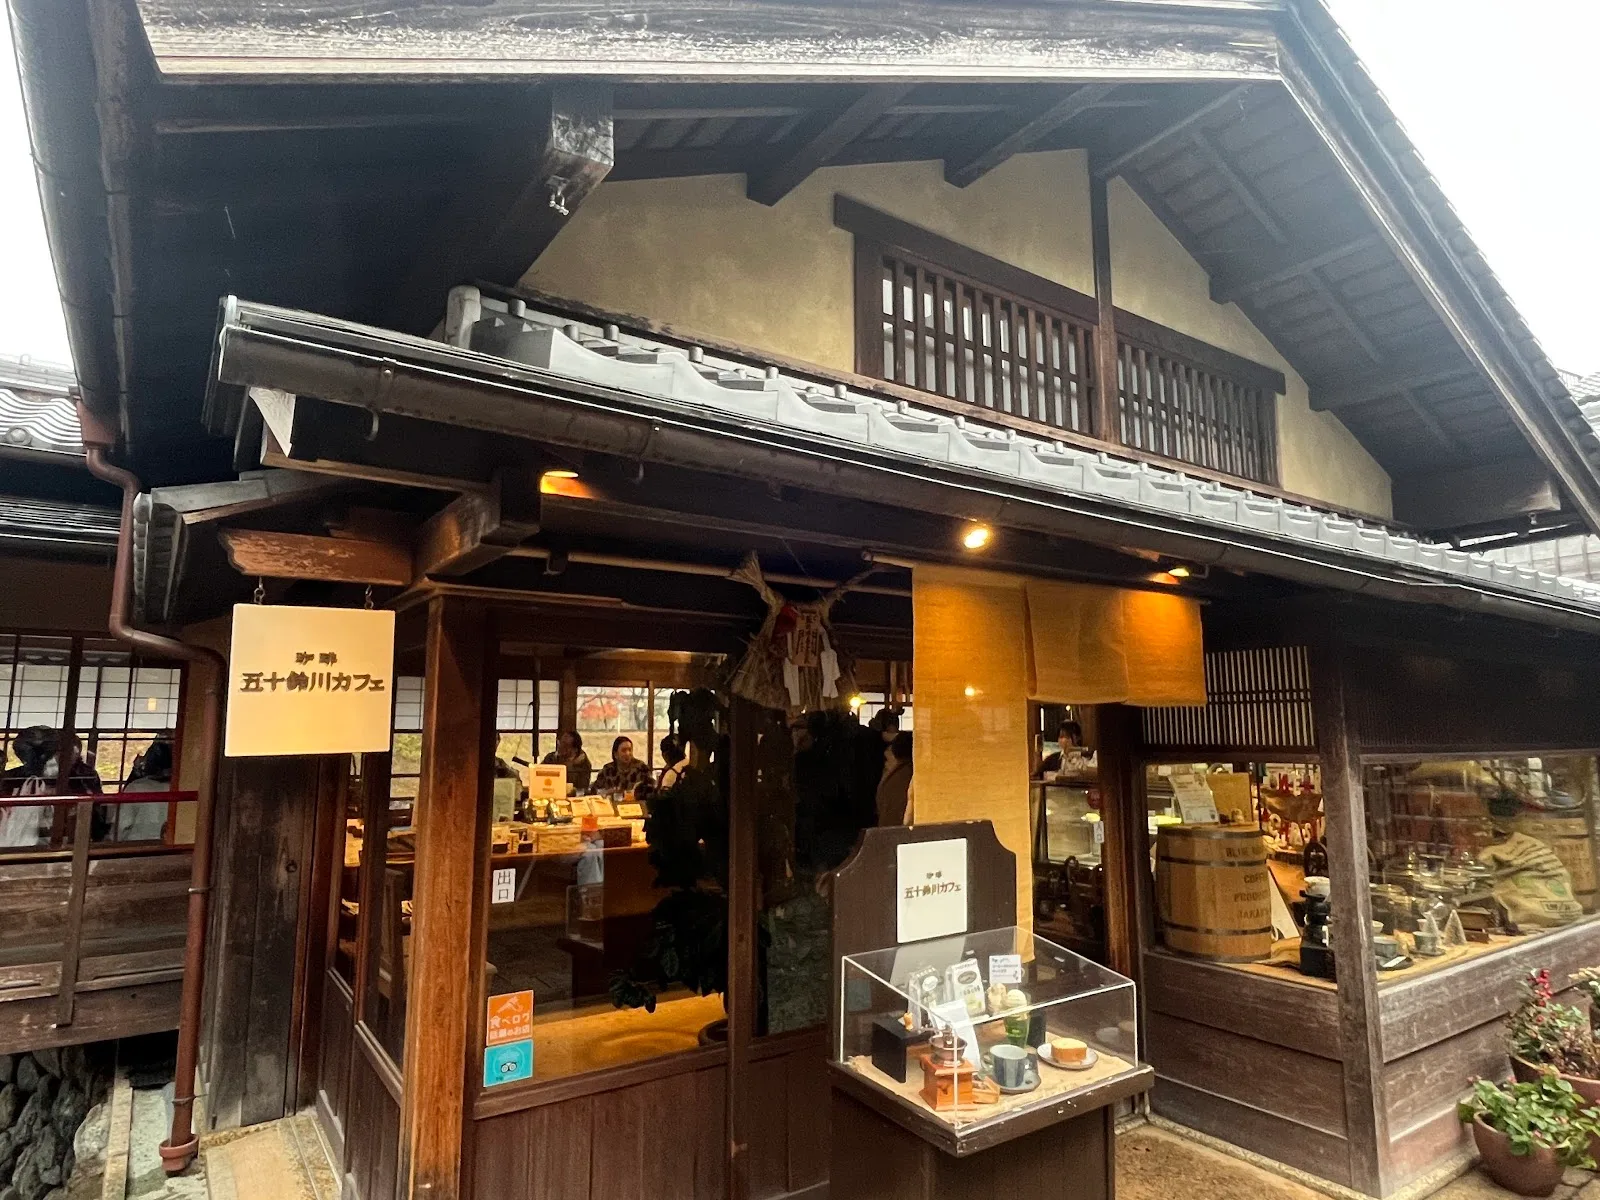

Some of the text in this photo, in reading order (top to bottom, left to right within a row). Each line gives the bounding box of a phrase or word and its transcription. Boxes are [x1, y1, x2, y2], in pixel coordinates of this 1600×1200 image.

[295, 651, 338, 667] 珈琲
[240, 671, 385, 692] 五十鈴川カフェ
[497, 870, 511, 900] 出口
[904, 881, 962, 899] 五十鈴川カフェ
[490, 1011, 530, 1029] 食べログ
